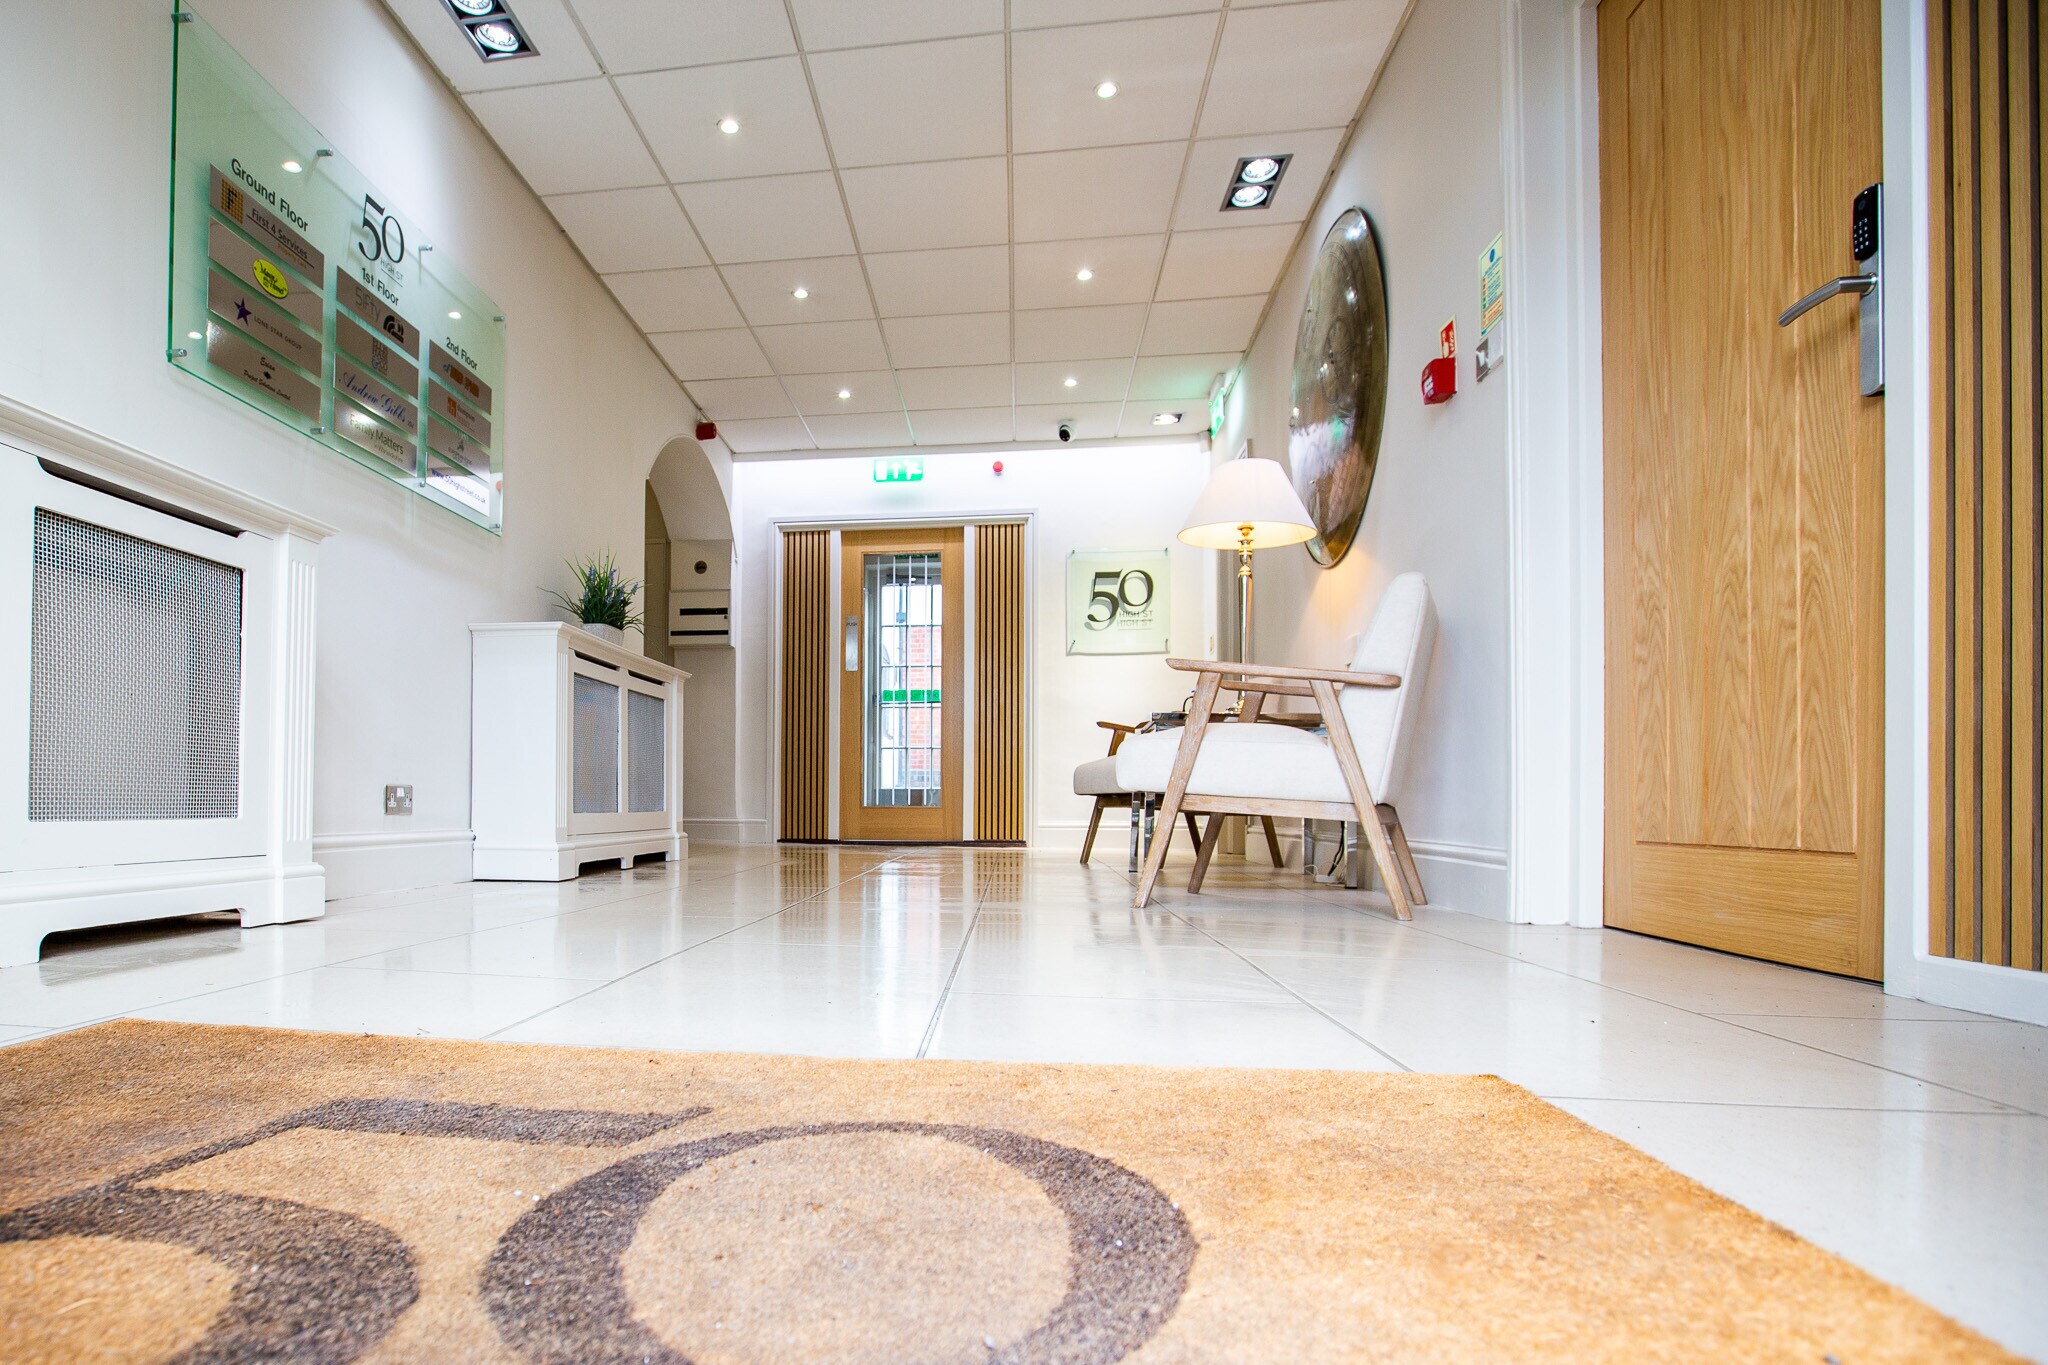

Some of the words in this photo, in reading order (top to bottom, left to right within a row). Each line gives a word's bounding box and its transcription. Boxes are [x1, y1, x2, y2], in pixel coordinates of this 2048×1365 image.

[231, 157, 276, 206] Ground
[279, 198, 308, 232] Floor
[252, 207, 270, 230] First
[269, 224, 276, 235] 4
[277, 231, 308, 260] Services
[358, 192, 405, 264] 50
[361, 267, 375, 288] 1st
[377, 280, 400, 306] Floor
[380, 258, 395, 276] HIGH
[395, 270, 404, 281] ST
[270, 326, 284, 340] STAR
[284, 335, 302, 351] GROUP
[446, 336, 459, 356] 2nd
[460, 348, 478, 371] Floor
[375, 429, 404, 456] Matters
[1087, 567, 1154, 623] 50
[1118, 609, 1140, 618] HIGH
[1142, 608, 1154, 618] ST
